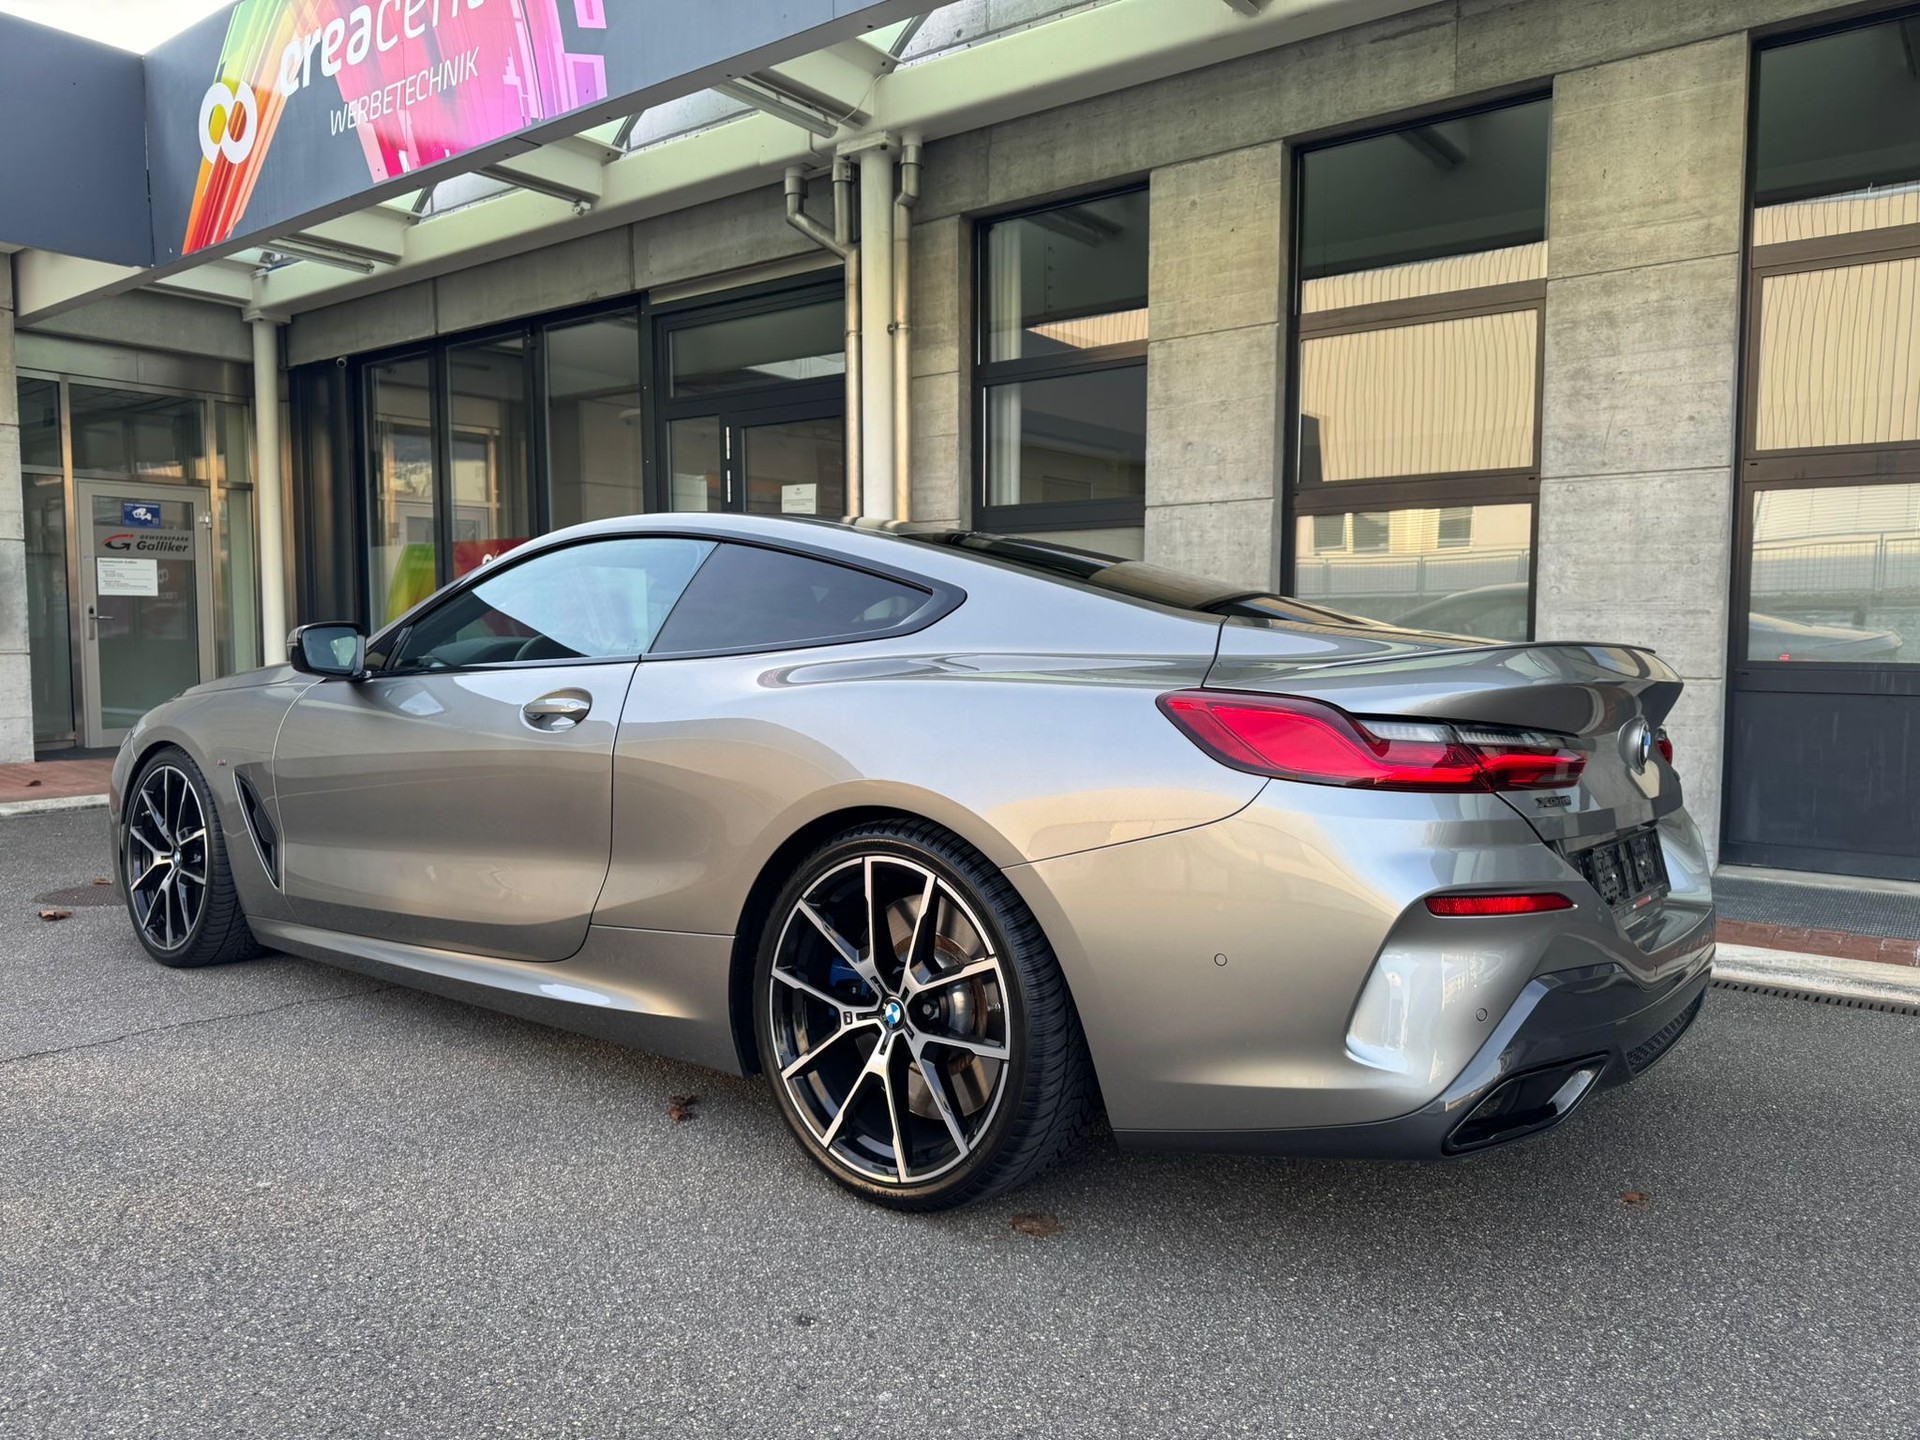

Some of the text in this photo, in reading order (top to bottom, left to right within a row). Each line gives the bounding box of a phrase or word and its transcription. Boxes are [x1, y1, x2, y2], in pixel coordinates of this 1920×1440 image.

[280, 0, 484, 97] creacen
[330, 46, 480, 136] WERBETECHNIK
[136, 540, 189, 553] Galliker
